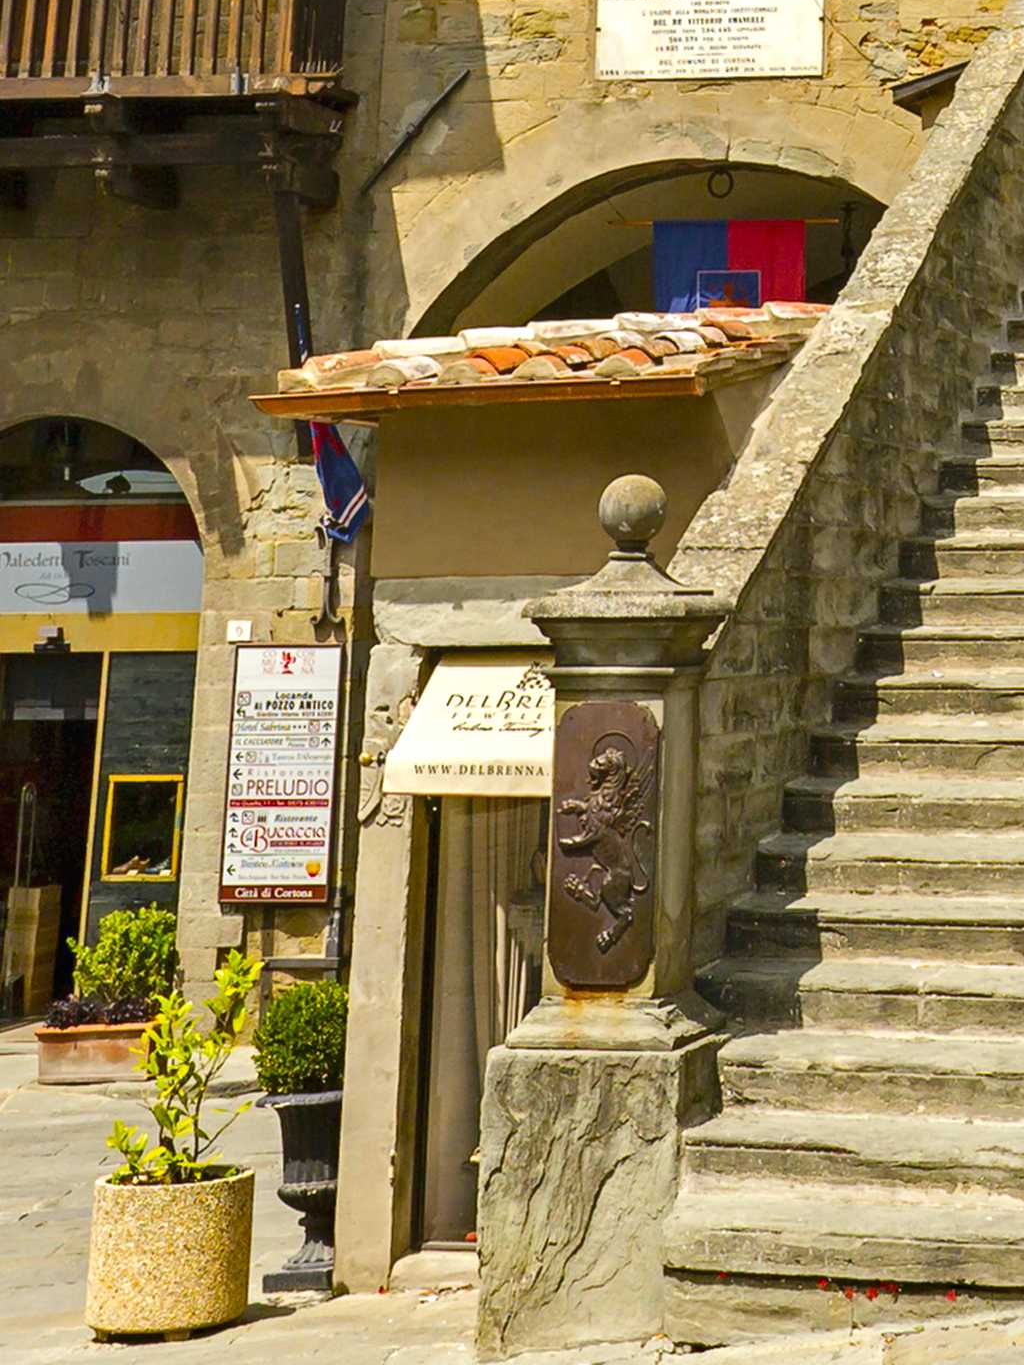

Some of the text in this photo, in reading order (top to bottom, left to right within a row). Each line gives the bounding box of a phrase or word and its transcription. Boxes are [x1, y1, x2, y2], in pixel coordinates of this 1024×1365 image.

[73, 550, 130, 569] Toscani
[275, 692, 313, 700] Locanda
[266, 700, 295, 710] POZZO
[299, 700, 334, 710] ANTICO
[246, 779, 330, 796] PRELUDIO
[234, 887, 313, 898] Città di Cortona
